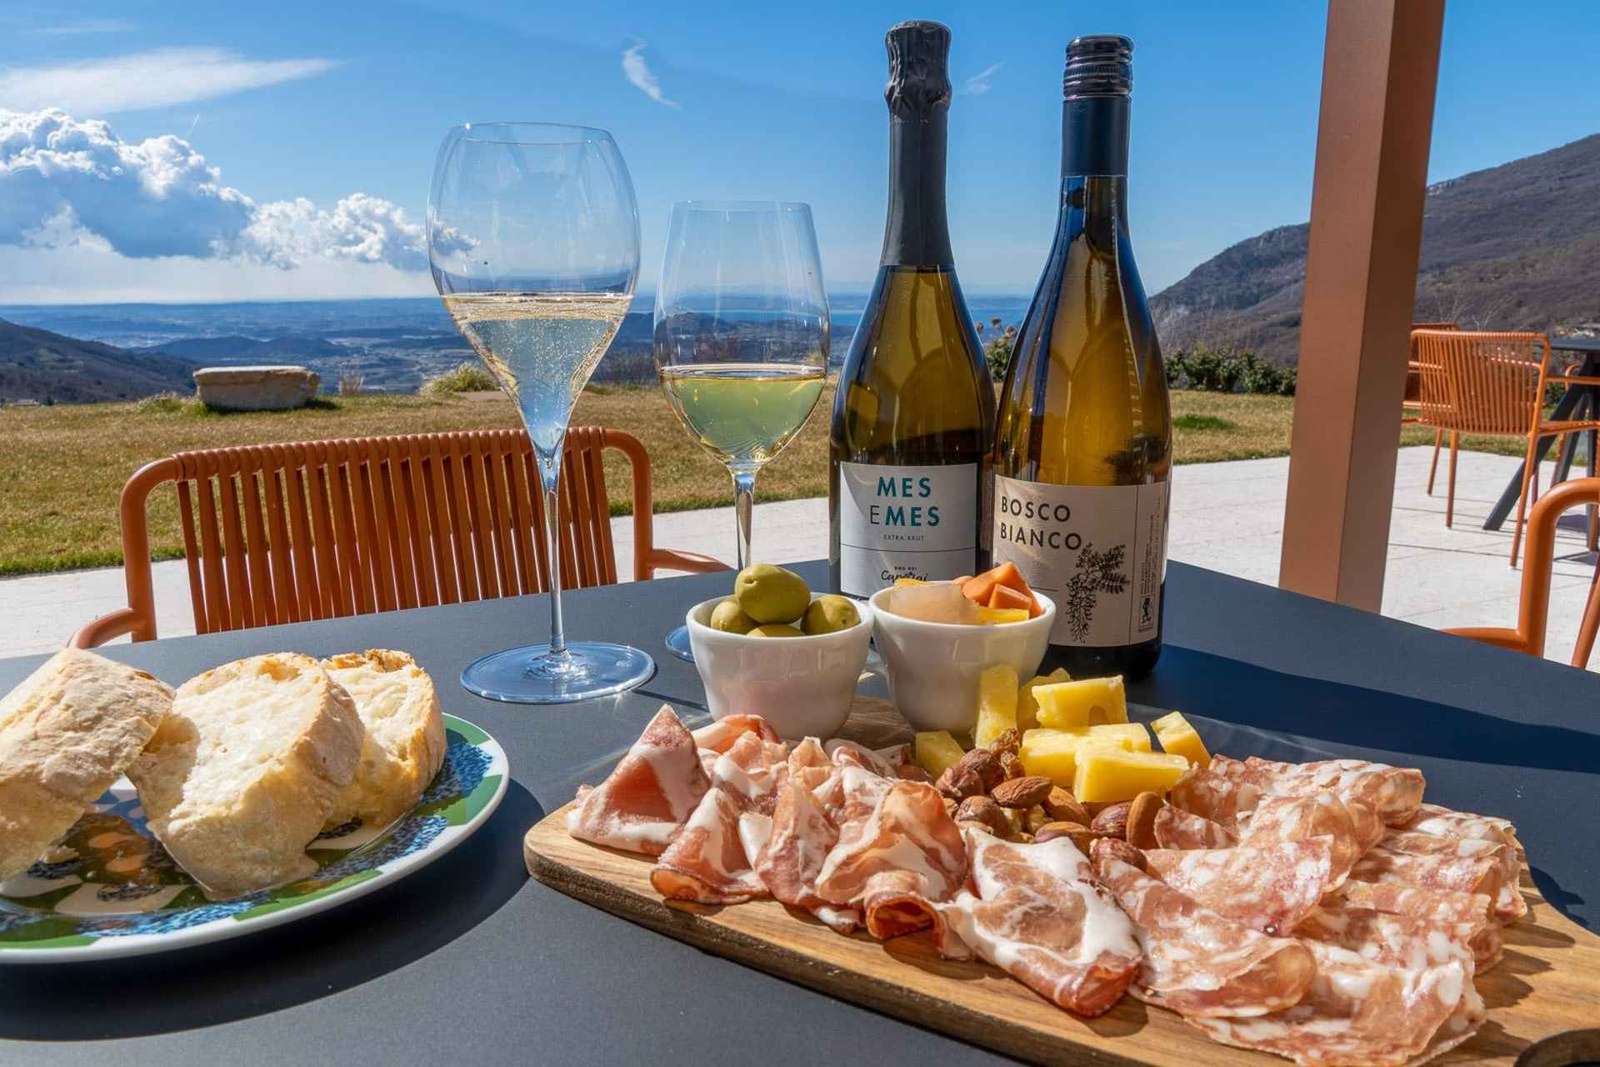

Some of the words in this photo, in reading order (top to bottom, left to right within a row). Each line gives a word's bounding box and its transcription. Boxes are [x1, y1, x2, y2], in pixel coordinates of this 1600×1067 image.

[877, 476, 931, 498] MES
[1001, 496, 1071, 522] BOSCO
[1000, 522, 1082, 550] BIANCO
